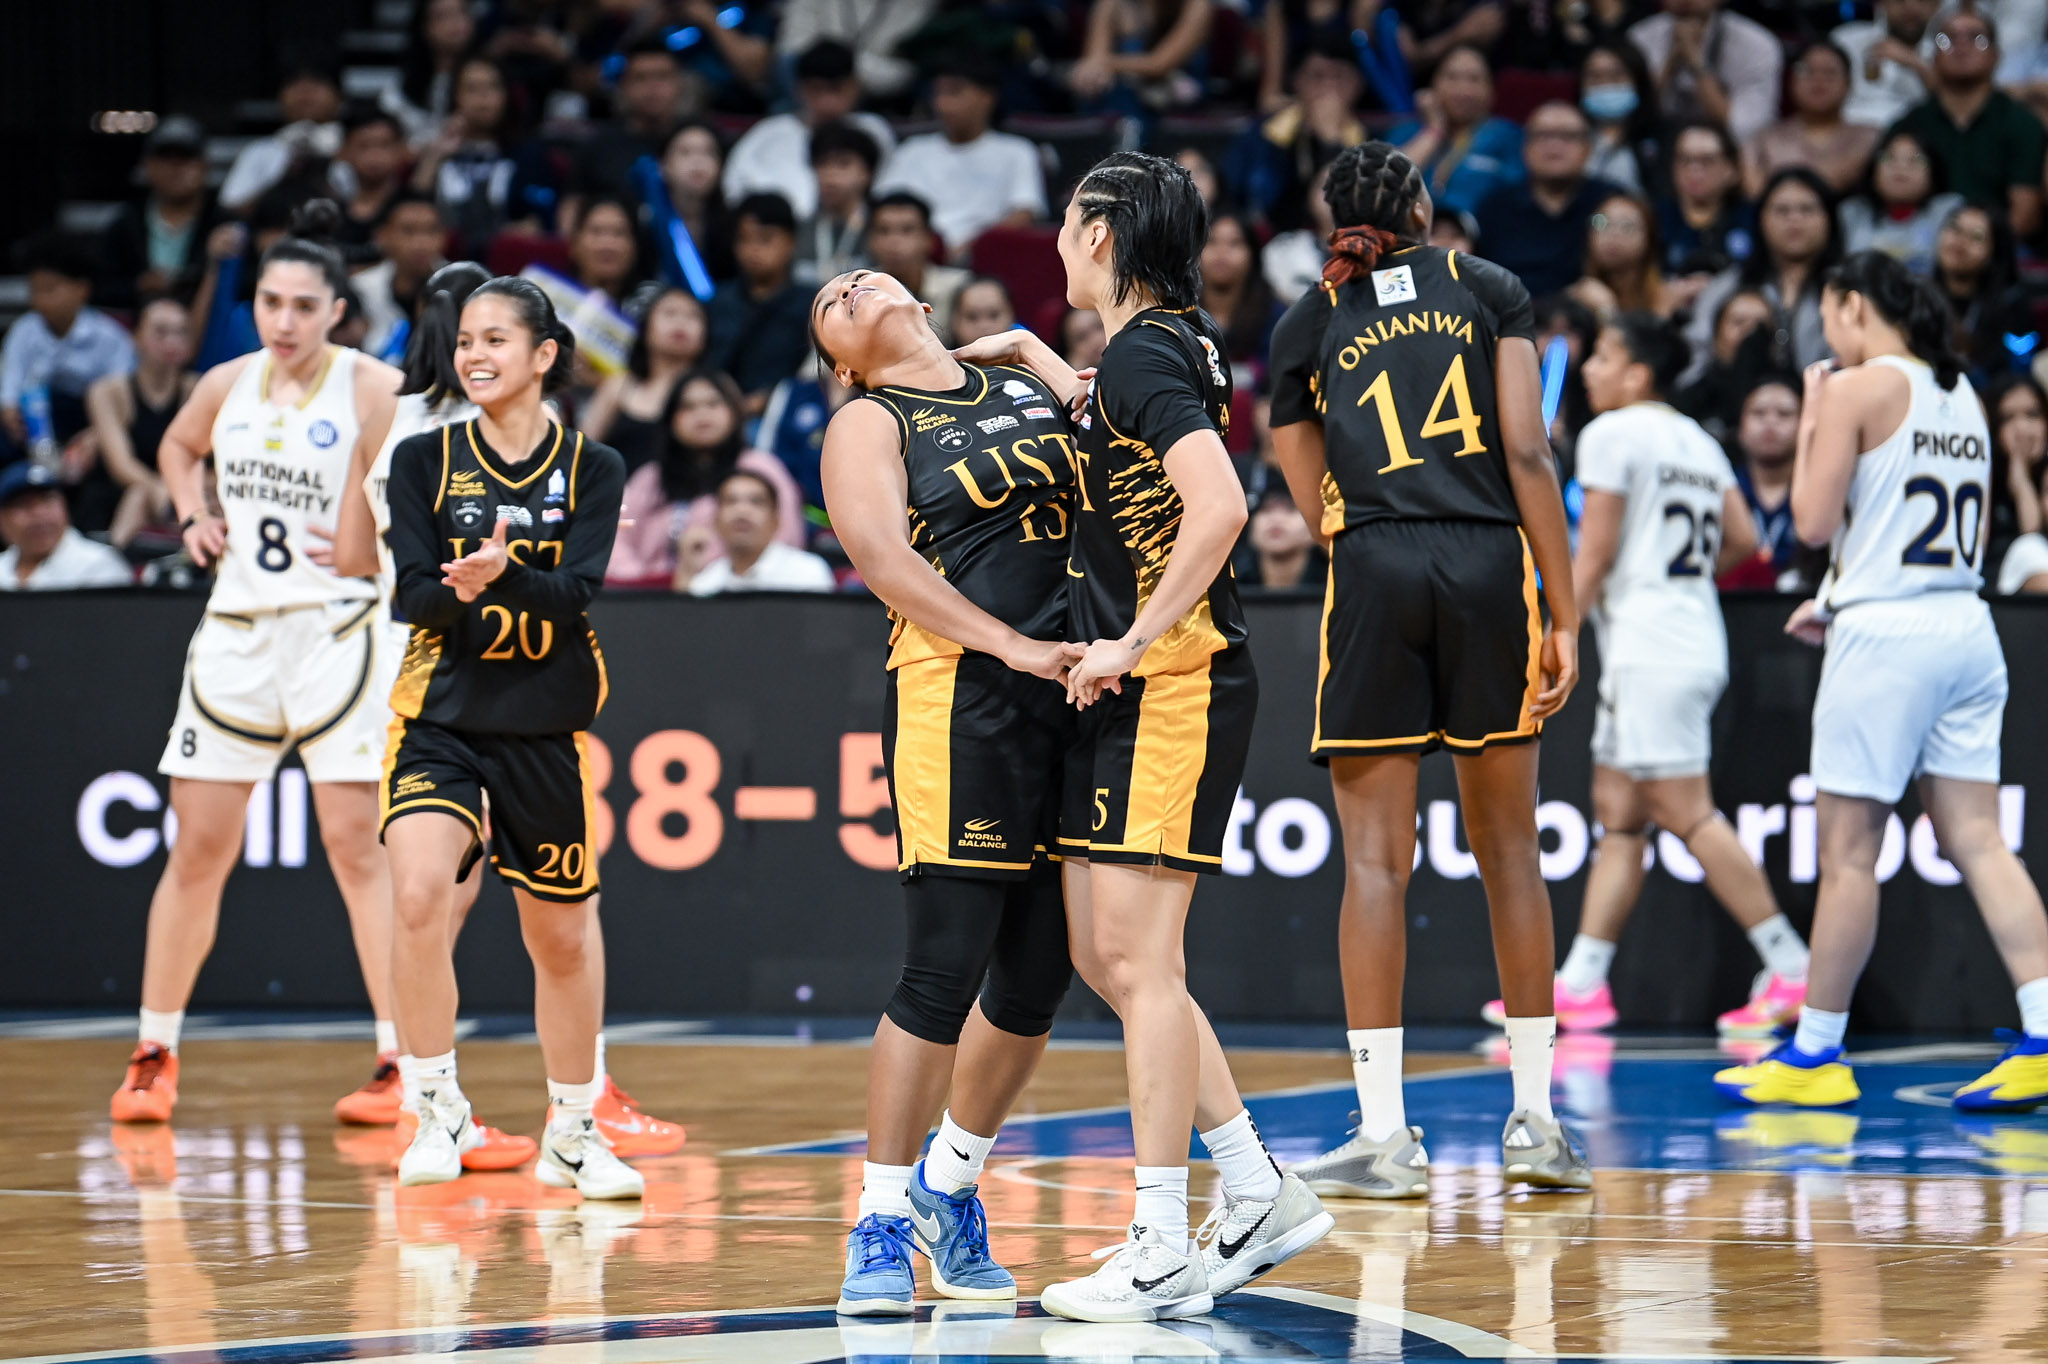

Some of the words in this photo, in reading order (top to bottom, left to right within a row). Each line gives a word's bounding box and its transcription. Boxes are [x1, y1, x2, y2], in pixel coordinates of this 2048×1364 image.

[1338, 311, 1473, 370] ONIANWA
[1356, 353, 1488, 475] 14
[225, 459, 323, 490] NATIONAL
[943, 433, 1077, 509] UST
[257, 517, 292, 573] 8
[1902, 475, 1983, 567] 20
[480, 604, 553, 660] 20
[182, 728, 196, 757] 8
[76, 768, 308, 868] cll
[958, 840, 1007, 849] BALANCE
[964, 832, 1003, 841] WORLD
[533, 842, 584, 880] 20
